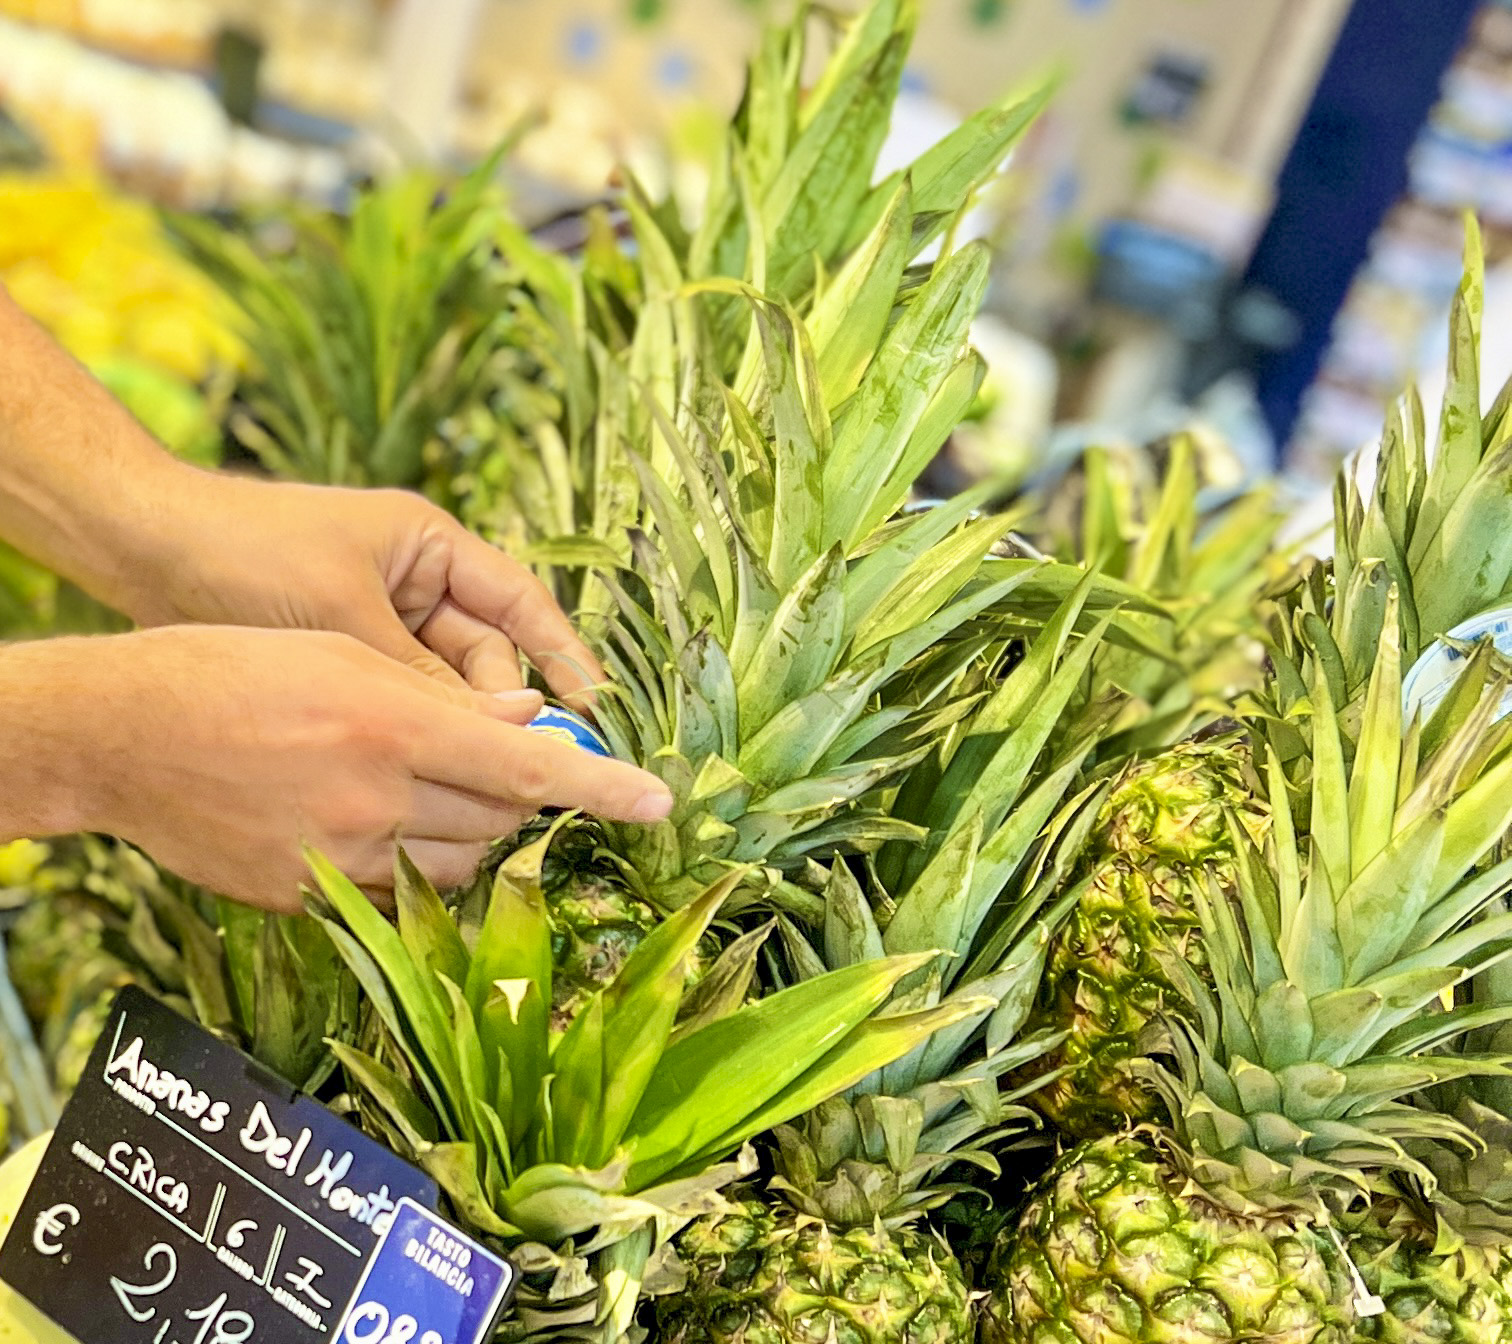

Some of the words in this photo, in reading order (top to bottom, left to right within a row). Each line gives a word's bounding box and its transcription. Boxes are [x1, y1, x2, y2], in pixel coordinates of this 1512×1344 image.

[108, 1036, 230, 1132] Ananas
[240, 1101, 312, 1176] Del
[304, 1149, 395, 1236] Monte
[405, 1239, 475, 1297] BILANCIA
[427, 1226, 472, 1265] TASTO
